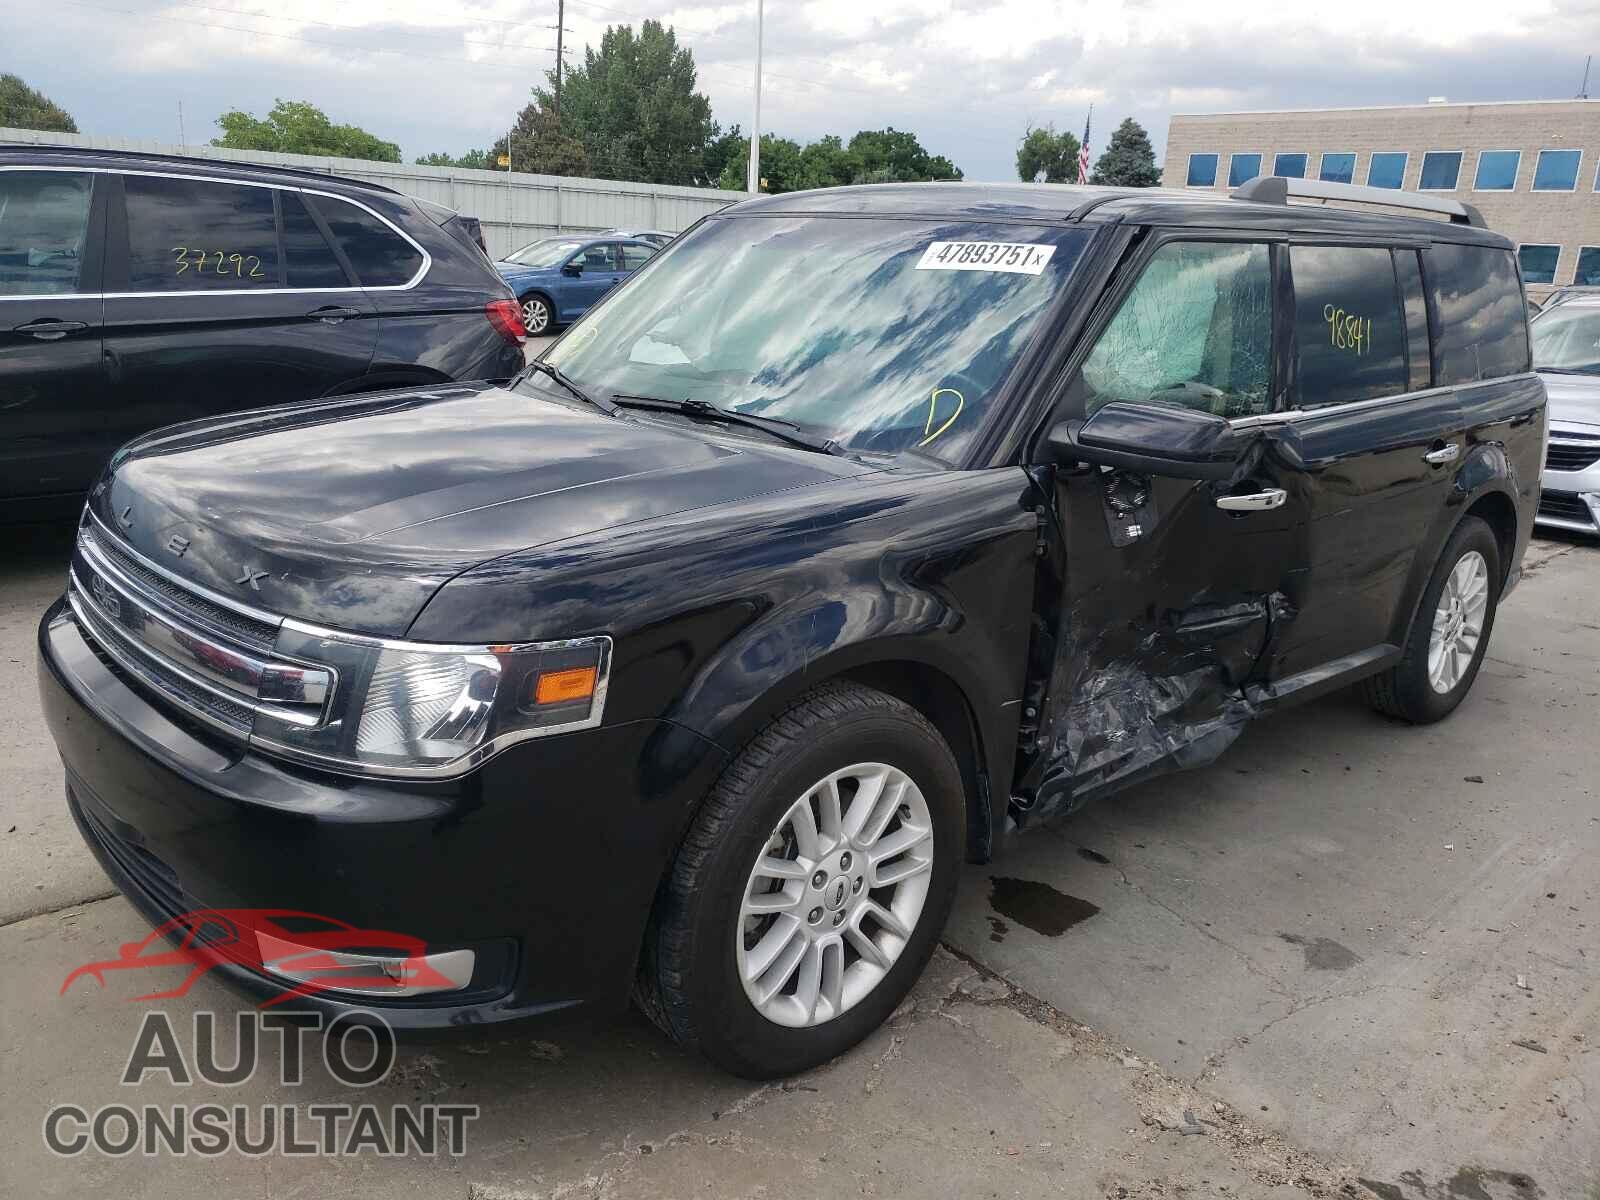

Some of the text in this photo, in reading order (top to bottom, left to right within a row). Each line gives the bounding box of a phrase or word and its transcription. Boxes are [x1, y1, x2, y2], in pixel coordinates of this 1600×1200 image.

[171, 247, 265, 278] 37292
[1323, 303, 1371, 356] 98841
[918, 388, 964, 447] D
